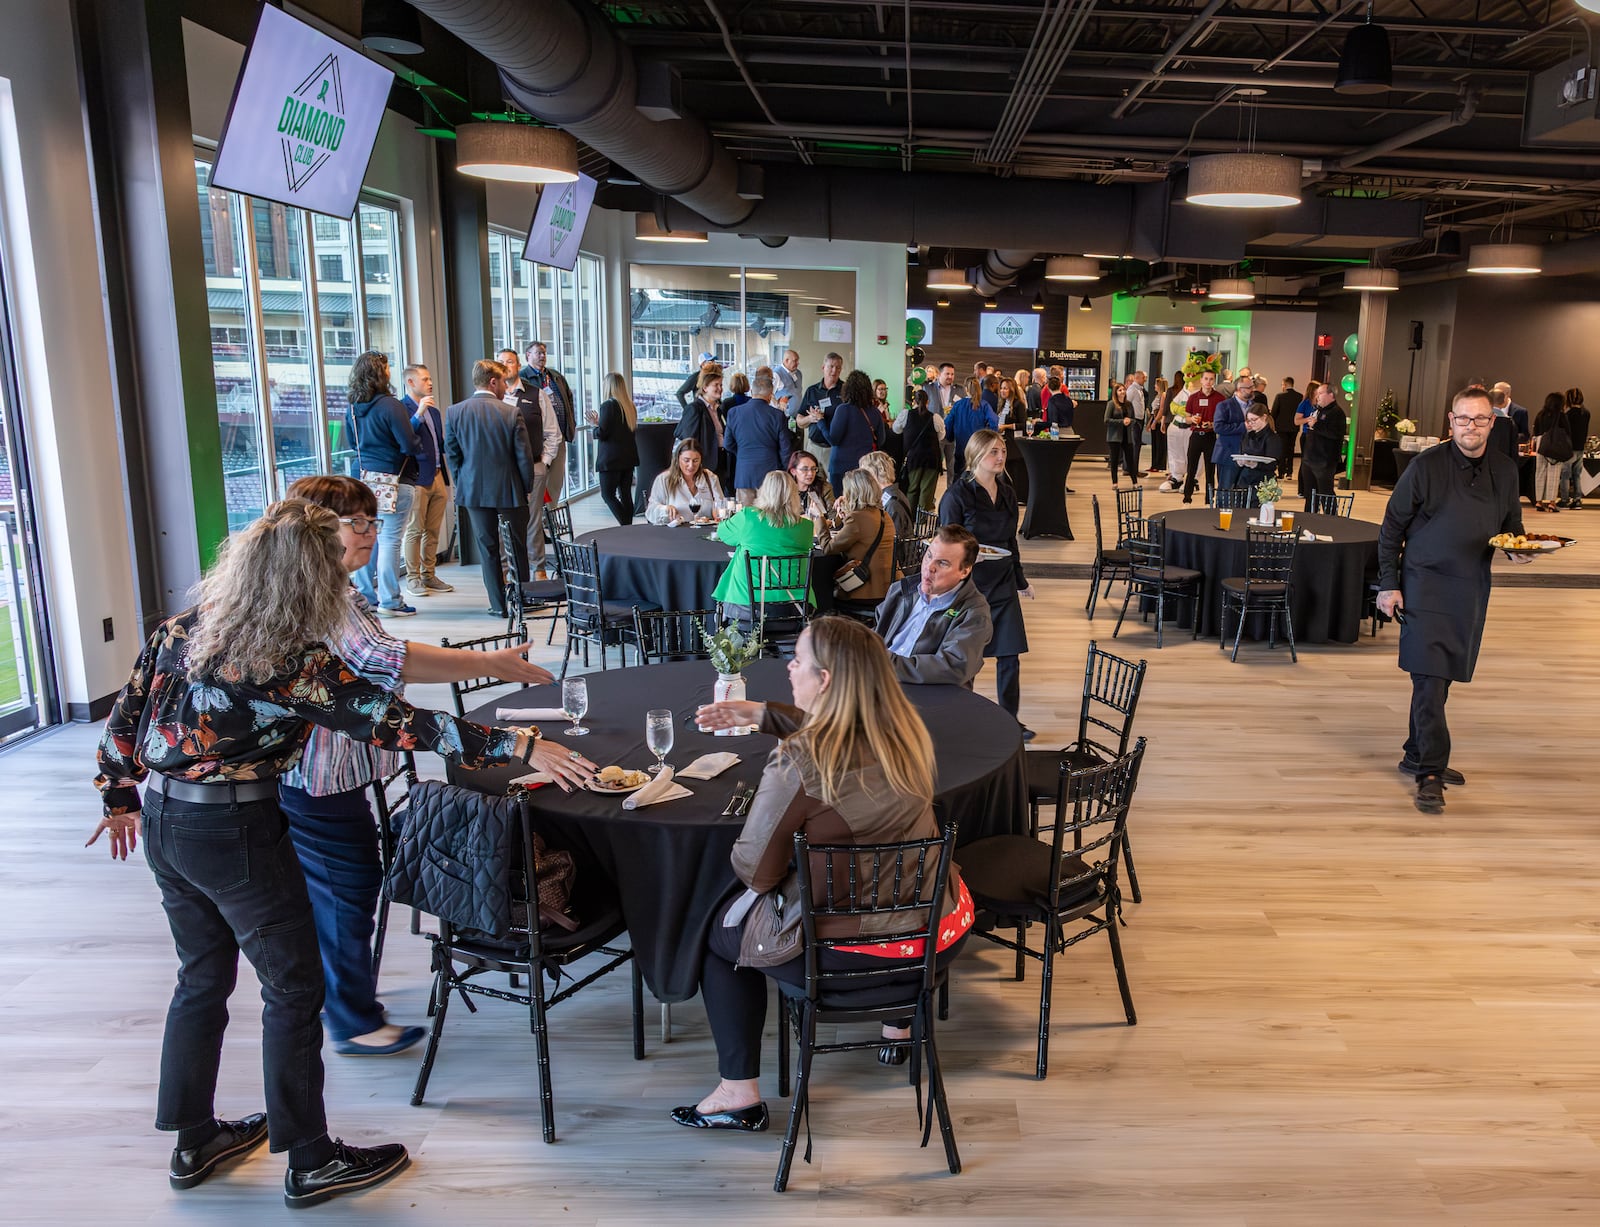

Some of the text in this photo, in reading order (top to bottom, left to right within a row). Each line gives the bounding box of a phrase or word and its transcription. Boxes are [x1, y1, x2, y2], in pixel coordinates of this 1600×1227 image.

[277, 95, 346, 152] DIAMOND
[294, 143, 315, 166] CLUB
[995, 326, 1024, 335] DIAMOND
[1049, 350, 1088, 359] Budweiser
